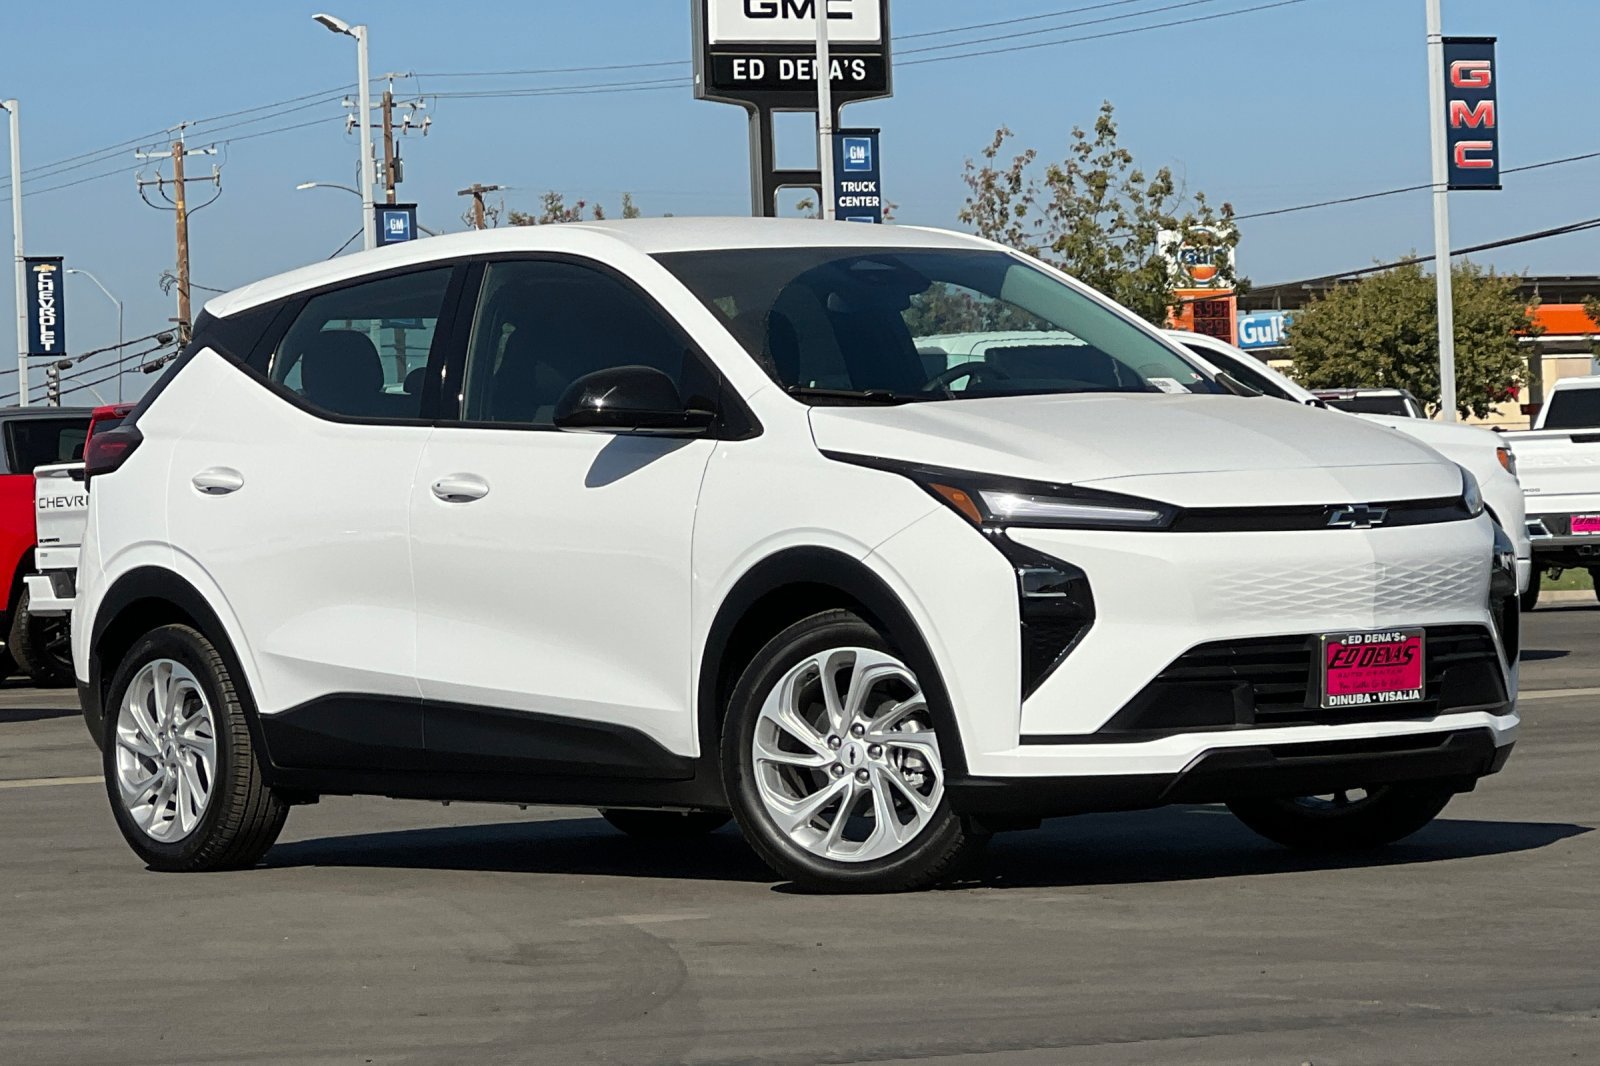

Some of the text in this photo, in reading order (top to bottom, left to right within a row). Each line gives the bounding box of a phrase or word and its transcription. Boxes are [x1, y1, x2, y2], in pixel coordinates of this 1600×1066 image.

[733, 59, 765, 80] ED
[1450, 60, 1495, 168] GMC
[850, 146, 865, 160] GM
[841, 181, 876, 192] TRUCK
[838, 196, 880, 207] CENTER
[390, 218, 404, 231] GM
[38, 273, 56, 351] CHEVROLET
[1348, 632, 1401, 644] ED DENA'S
[1328, 646, 1361, 669] ED
[1329, 690, 1420, 706] DINUBA VISALIA
